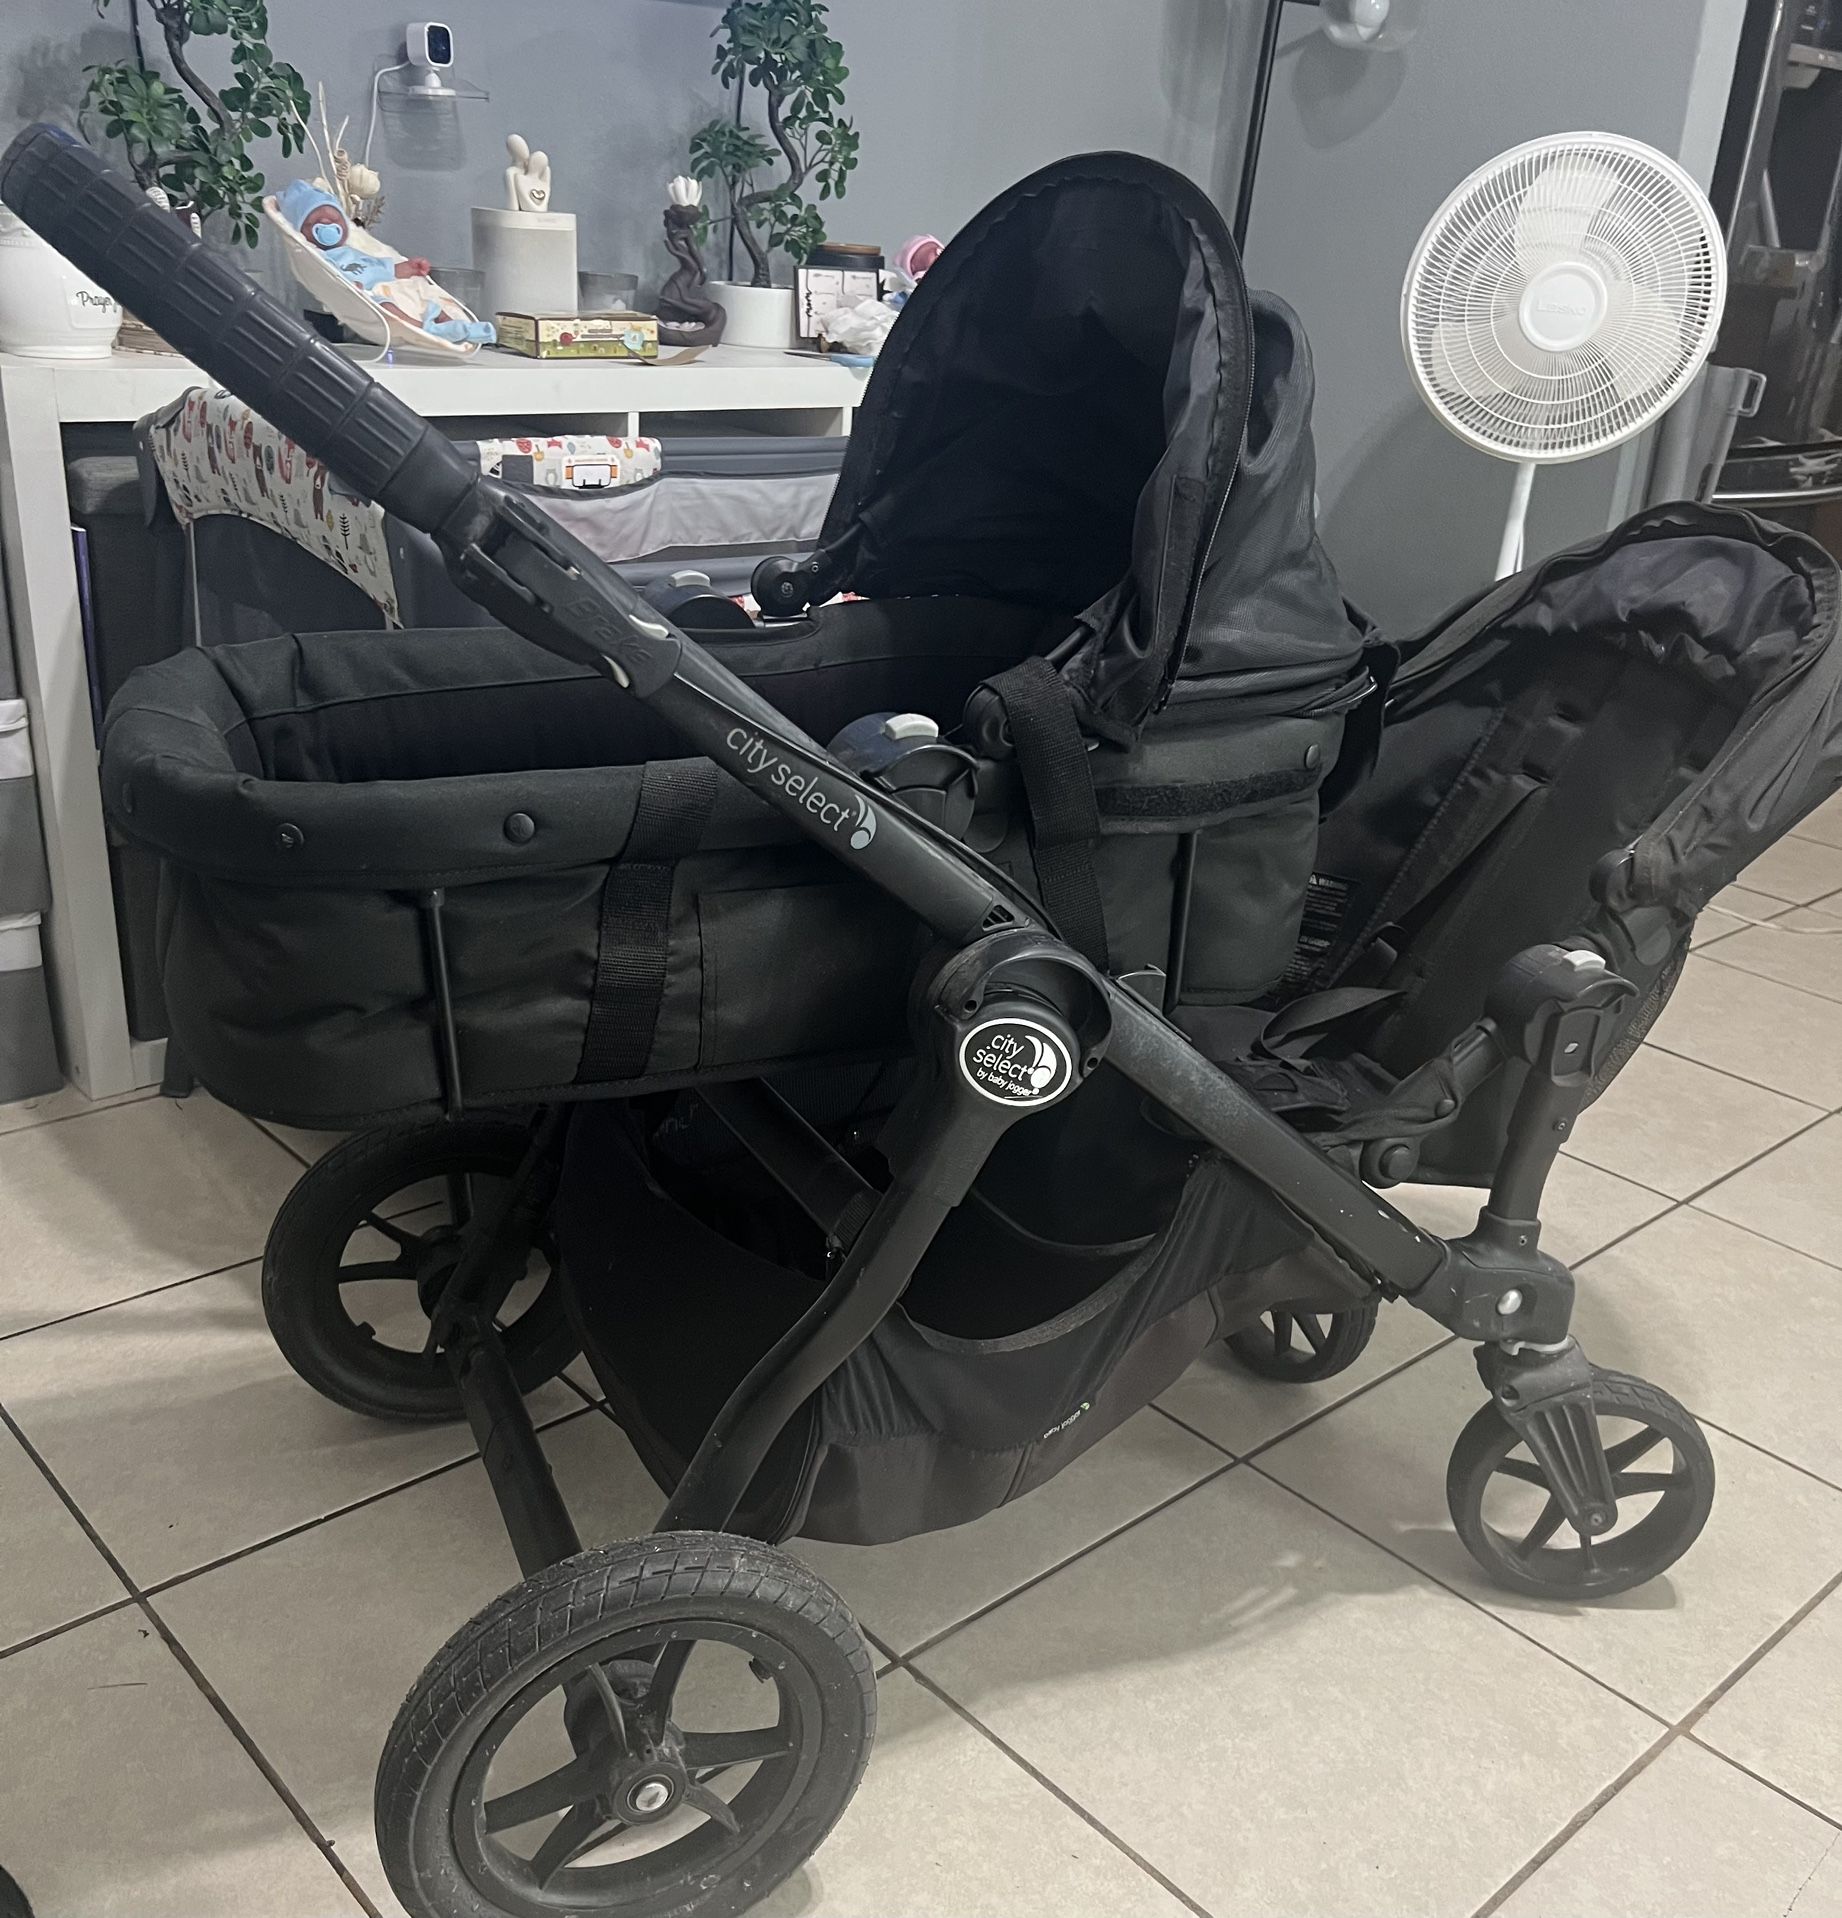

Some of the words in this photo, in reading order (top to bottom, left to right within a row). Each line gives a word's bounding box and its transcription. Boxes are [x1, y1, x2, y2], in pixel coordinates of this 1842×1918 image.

[726, 728, 778, 773] city
[771, 764, 850, 831] select
[991, 1034, 1025, 1060] city
[972, 1049, 1028, 1081] select
[976, 1067, 988, 1080] by
[987, 1072, 1009, 1089] baby
[1005, 1080, 1033, 1096] jogger
